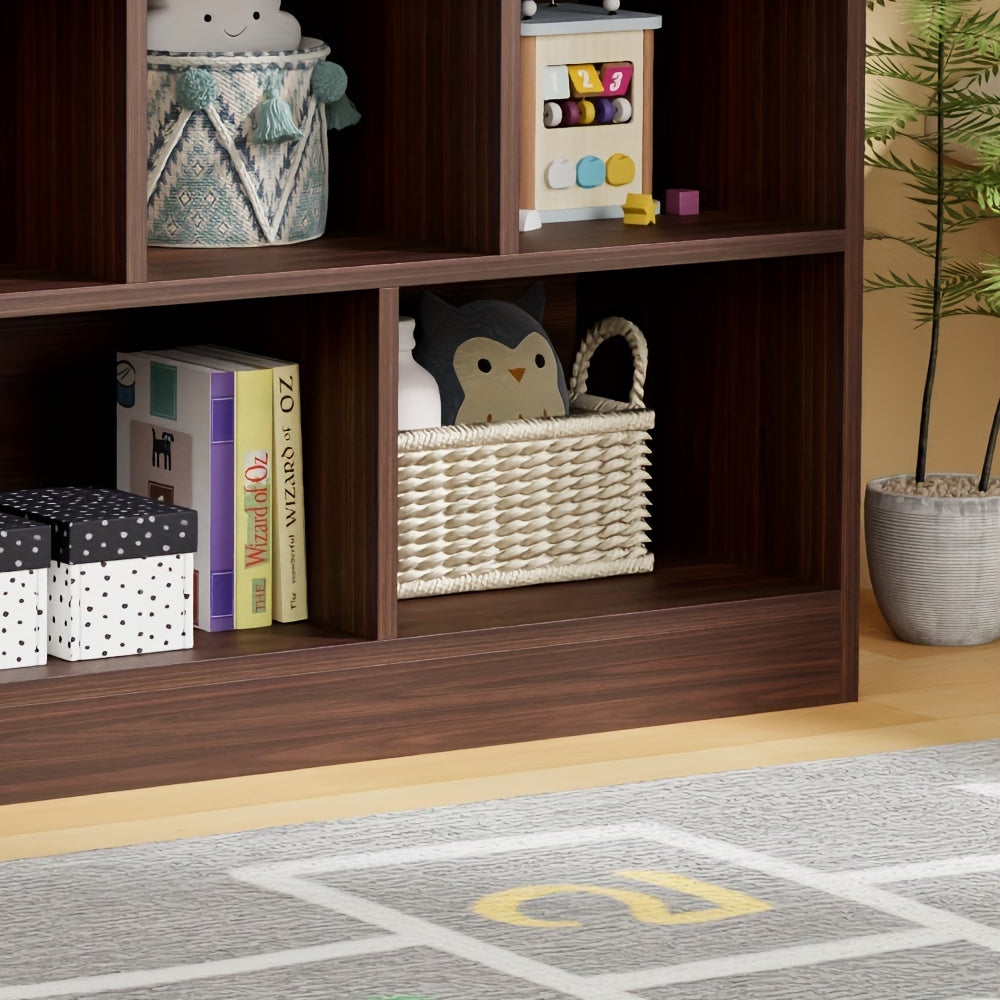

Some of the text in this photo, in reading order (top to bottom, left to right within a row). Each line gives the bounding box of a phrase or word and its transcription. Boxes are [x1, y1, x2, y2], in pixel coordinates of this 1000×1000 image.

[577, 69, 594, 89] 2
[609, 71, 623, 92] 3
[279, 375, 295, 414] OZ
[281, 446, 296, 528] WIZARD
[244, 452, 268, 612] THE Wizard of Oz
